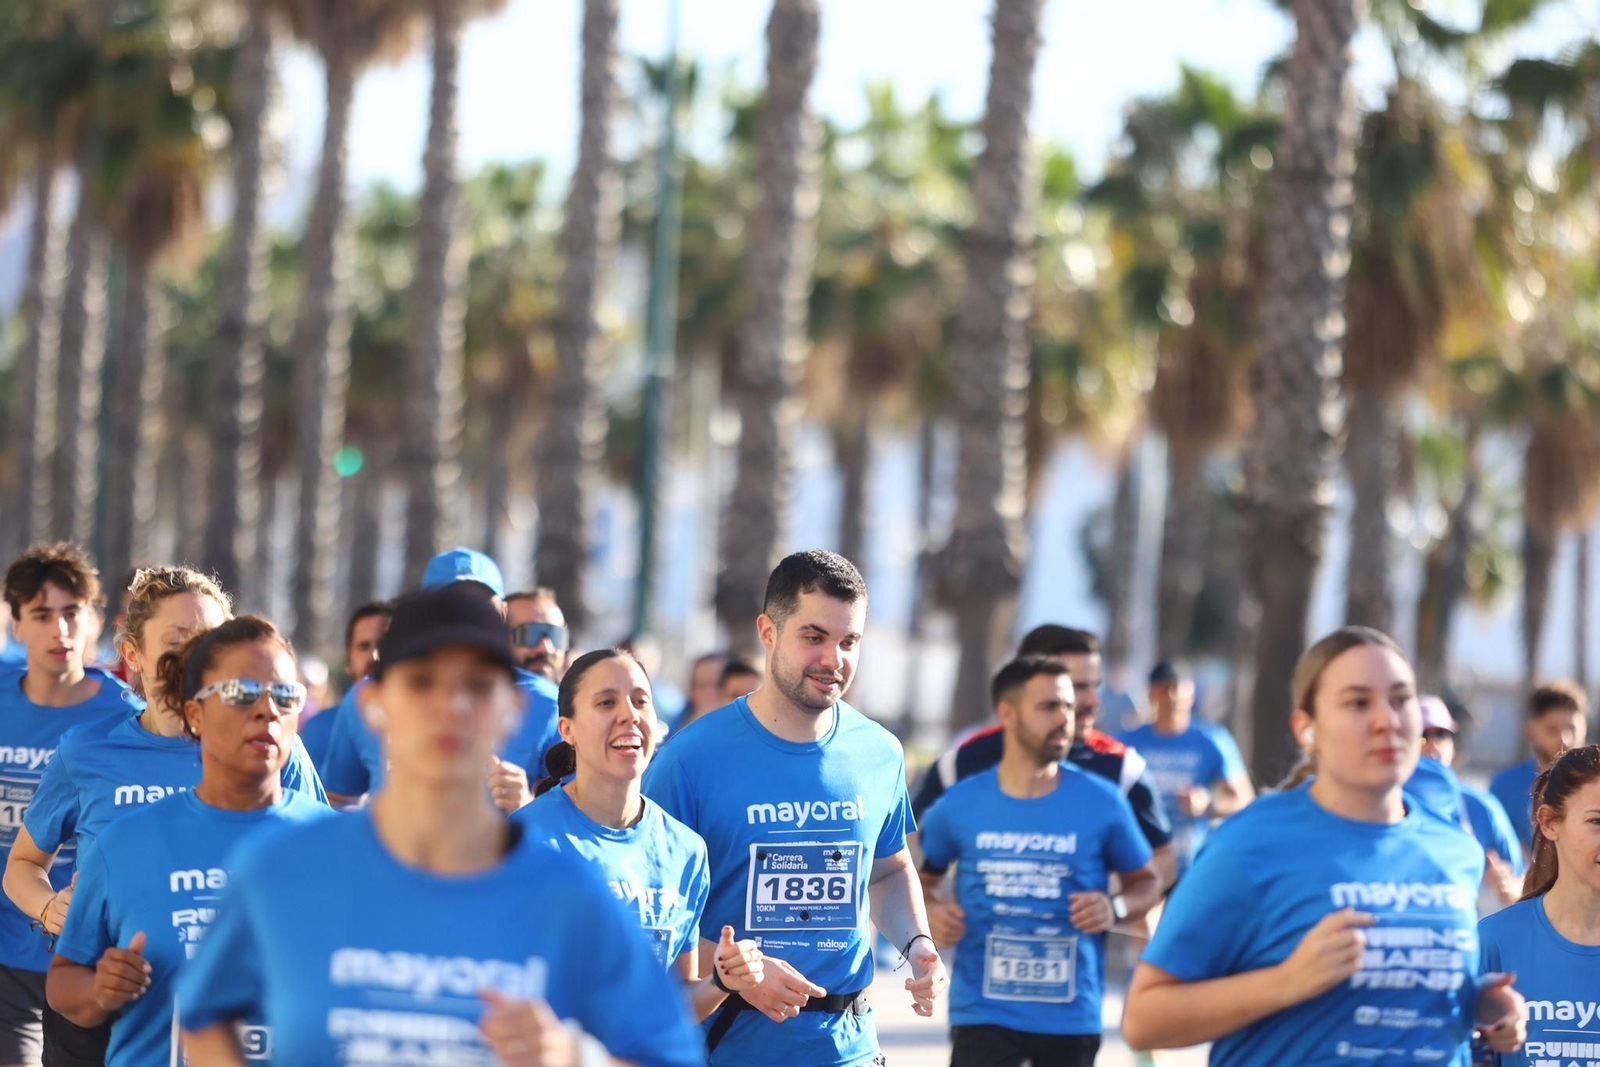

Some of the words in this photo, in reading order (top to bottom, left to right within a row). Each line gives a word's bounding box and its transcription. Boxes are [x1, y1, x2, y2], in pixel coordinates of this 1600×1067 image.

[746, 795, 865, 829] mayoral
[823, 847, 855, 856] maoral
[976, 833, 1077, 854] mayoral
[771, 861, 808, 870] Solidaria
[772, 853, 803, 862] Carrera
[764, 877, 846, 900] 1836
[1001, 961, 1061, 979] 1891
[1524, 1000, 1600, 1029] may
